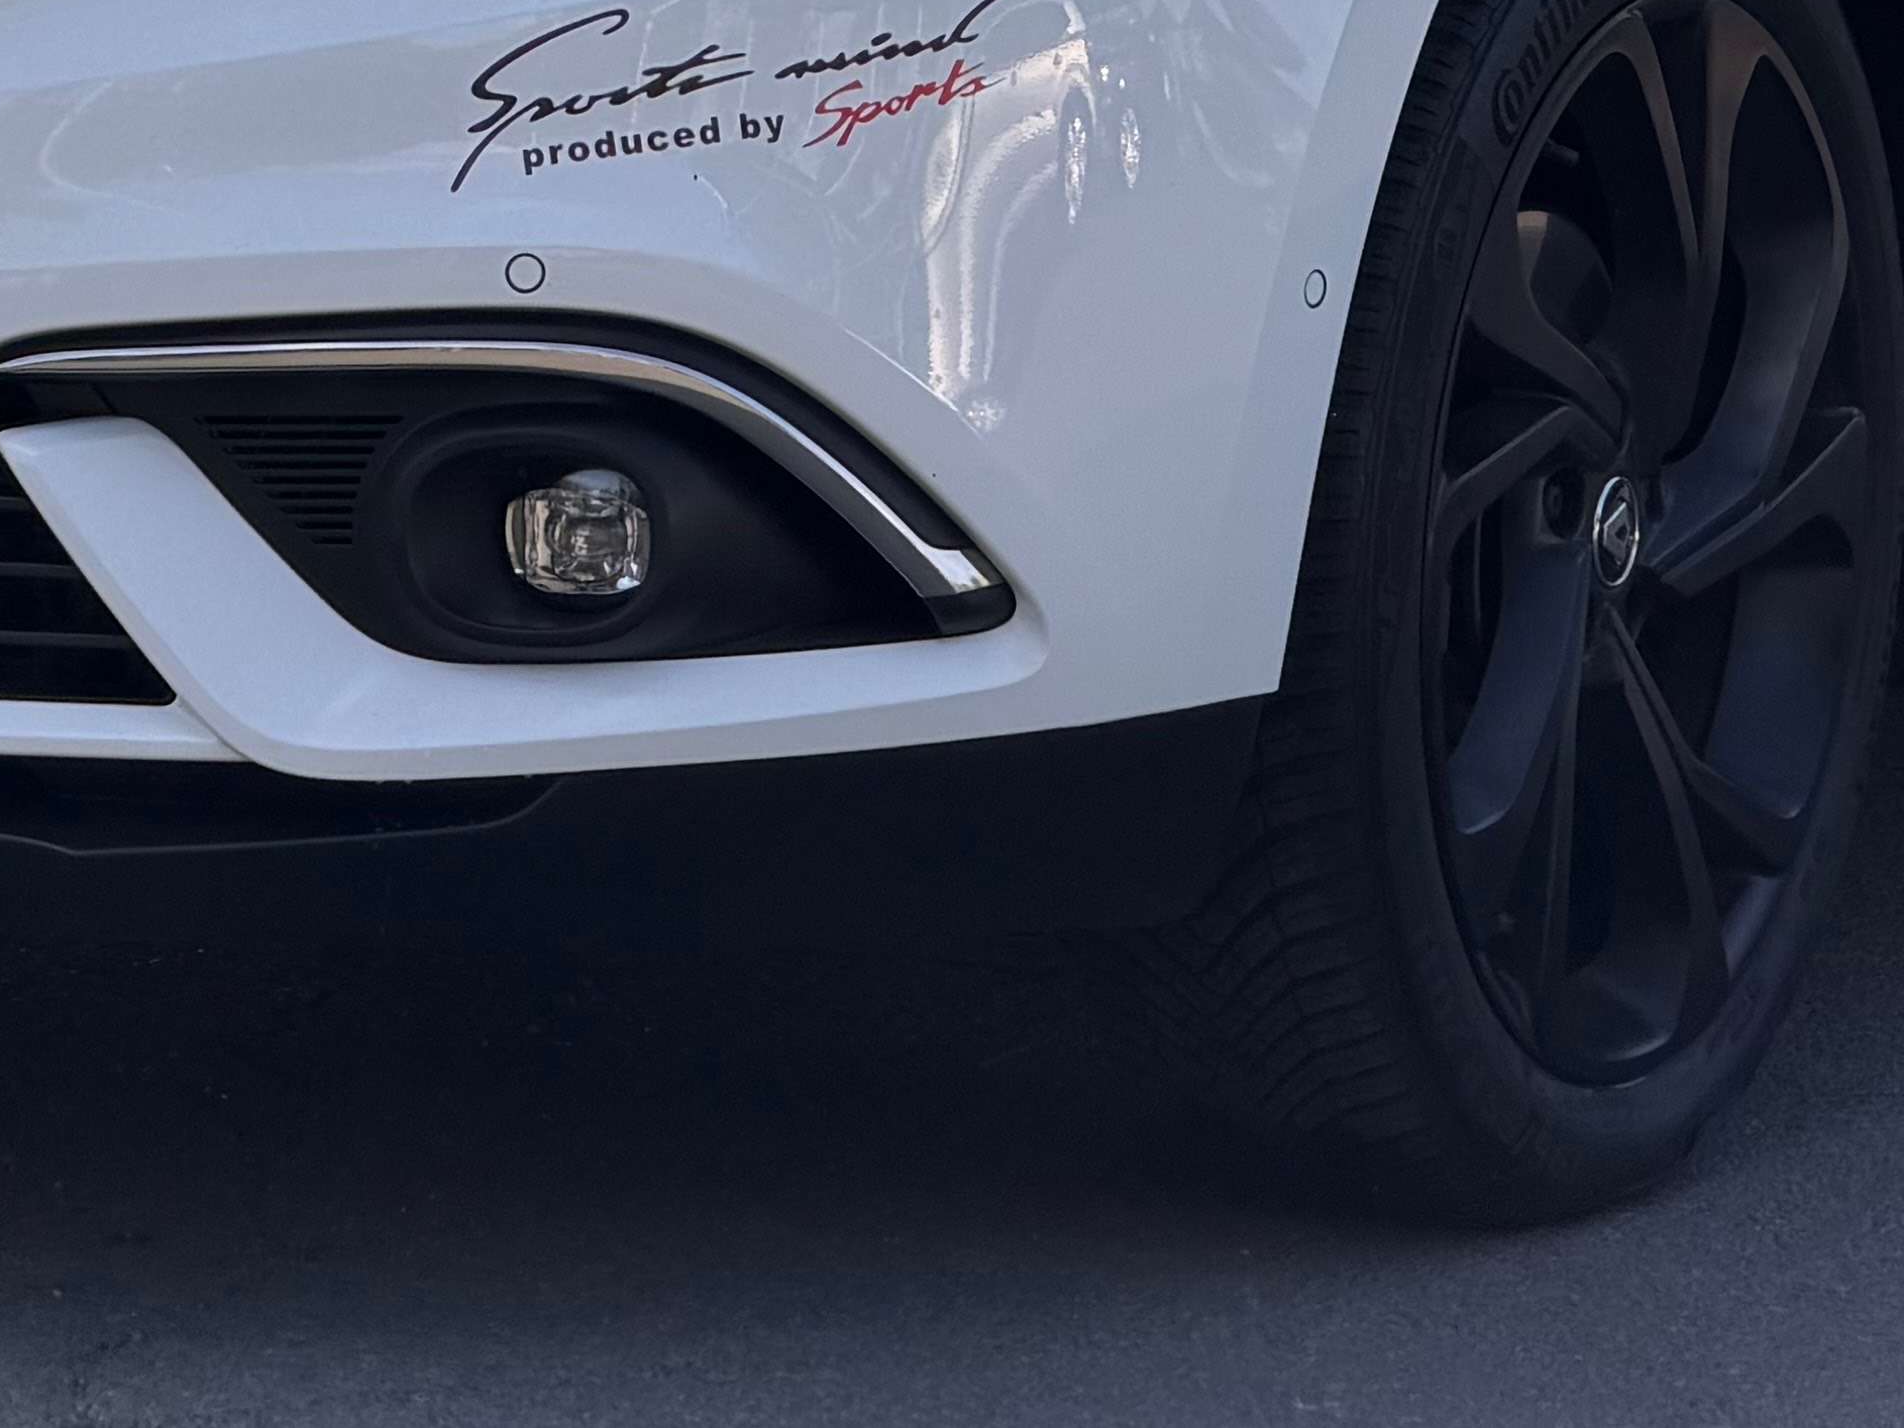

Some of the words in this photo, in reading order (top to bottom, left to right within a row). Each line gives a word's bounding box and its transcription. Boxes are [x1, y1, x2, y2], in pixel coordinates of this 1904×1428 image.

[522, 117, 721, 176] produced
[740, 112, 786, 147] by
[802, 59, 1007, 148] Sports
